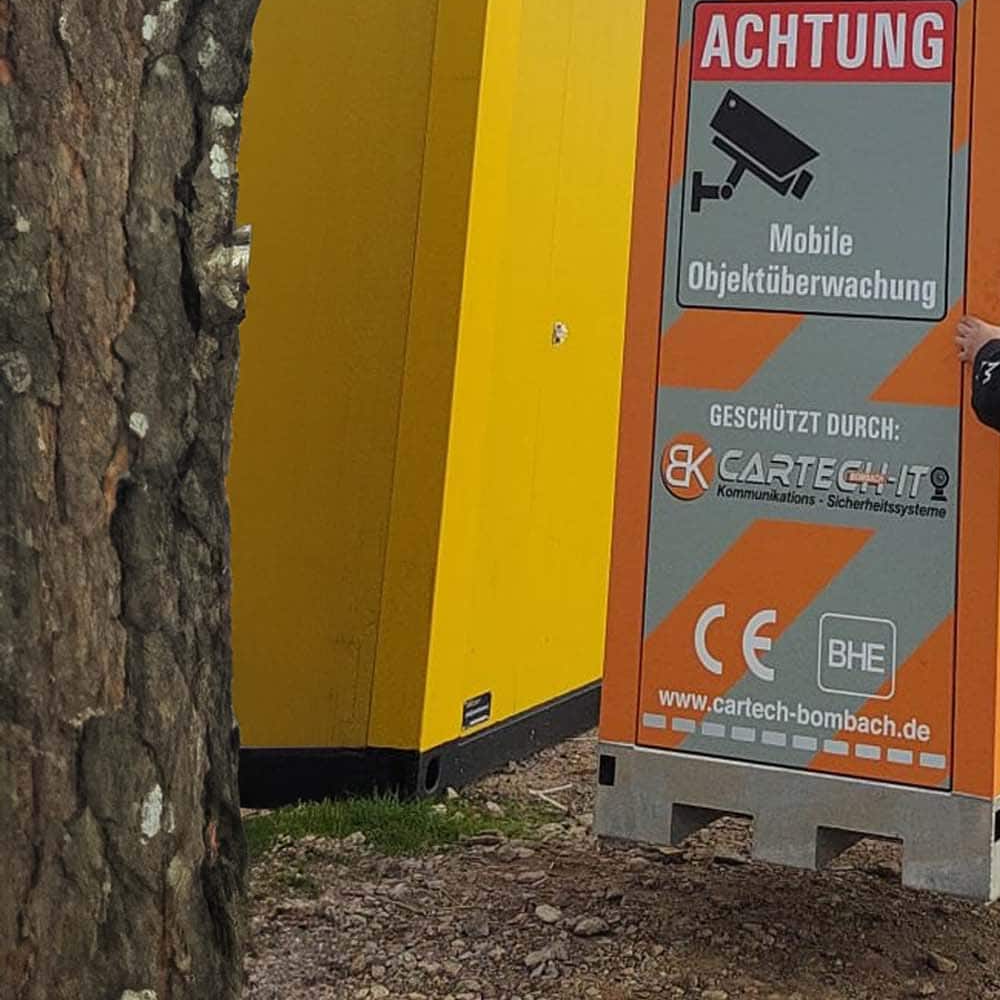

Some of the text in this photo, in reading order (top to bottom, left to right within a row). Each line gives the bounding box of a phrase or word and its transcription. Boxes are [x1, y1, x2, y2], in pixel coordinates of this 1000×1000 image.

[701, 10, 945, 70] ACHTUNG
[769, 222, 854, 257] Mobile
[688, 260, 937, 310] Objektüberwachung
[709, 403, 901, 441] GESCHÜTZT DURCH:
[718, 449, 930, 499] CARTECH-IT
[716, 484, 816, 506] Kommunikations
[826, 495, 947, 518] Sicherheitssysteme
[694, 603, 777, 681] CE
[827, 637, 887, 673] BHE
[658, 690, 931, 742] www.cartech-bombach.de
